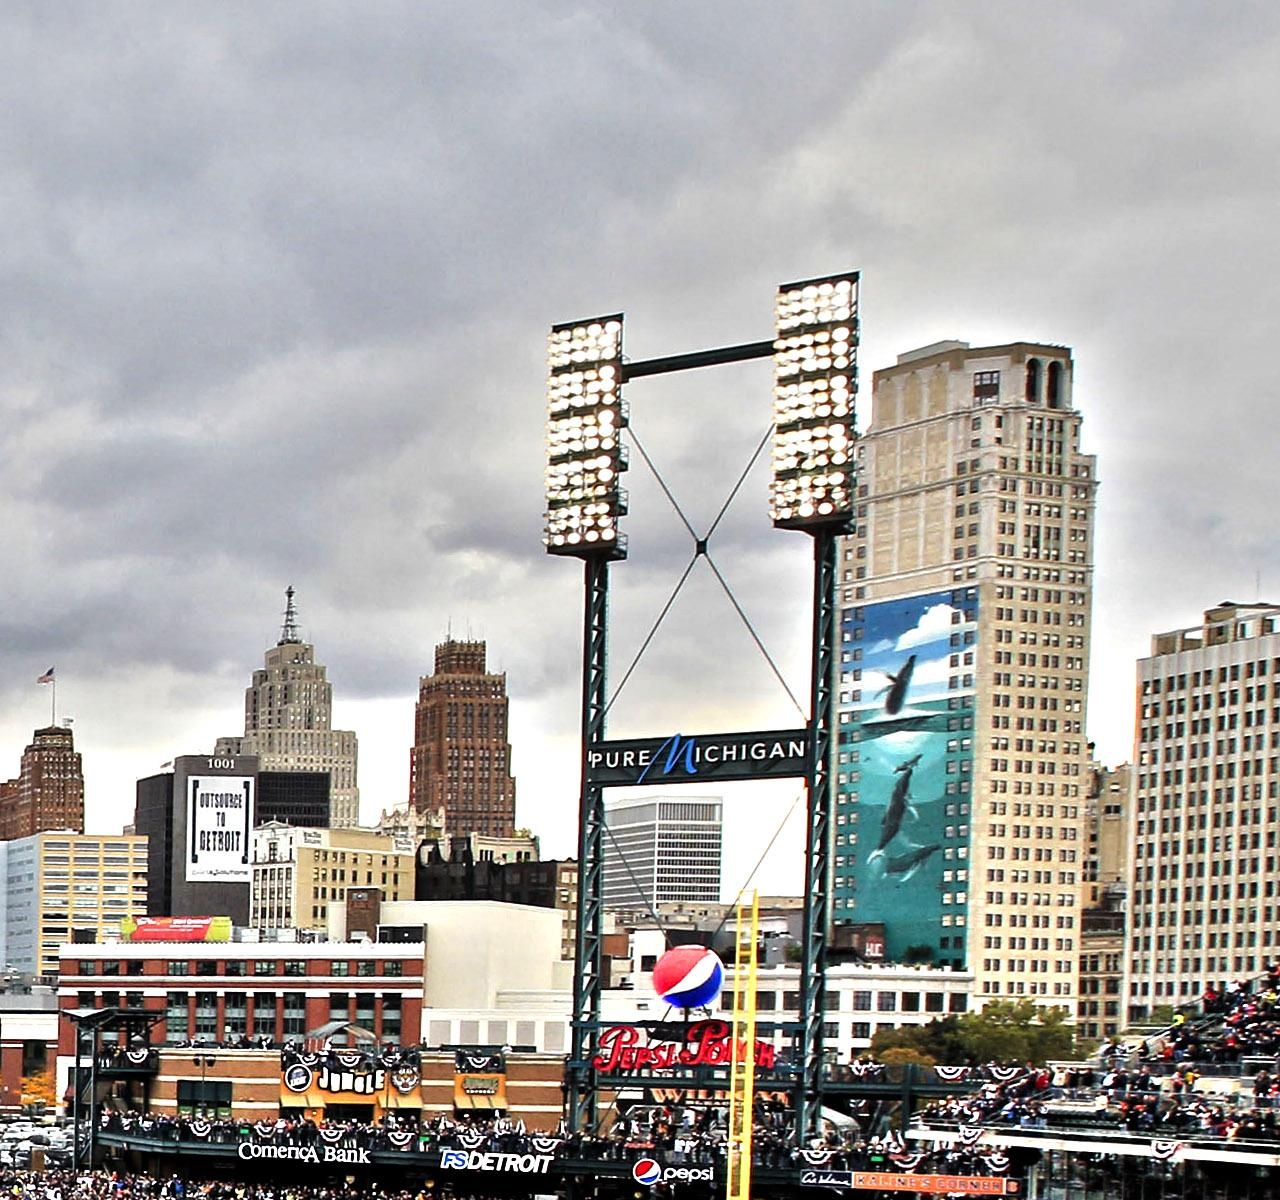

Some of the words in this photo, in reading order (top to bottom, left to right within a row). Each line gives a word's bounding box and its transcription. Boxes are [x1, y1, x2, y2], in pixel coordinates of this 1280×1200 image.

[207, 758, 236, 769] 1001
[591, 749, 651, 769] PURE
[637, 733, 805, 784] MICHIGAN
[199, 792, 243, 809] OUTSOURCE
[216, 811, 226, 827] TO
[199, 830, 241, 852] DETROIT
[592, 1025, 680, 1073] PEPSI
[318, 1066, 385, 1094] JUNGLE
[323, 1147, 371, 1165] Bank
[663, 1166, 715, 1181] pepsi
